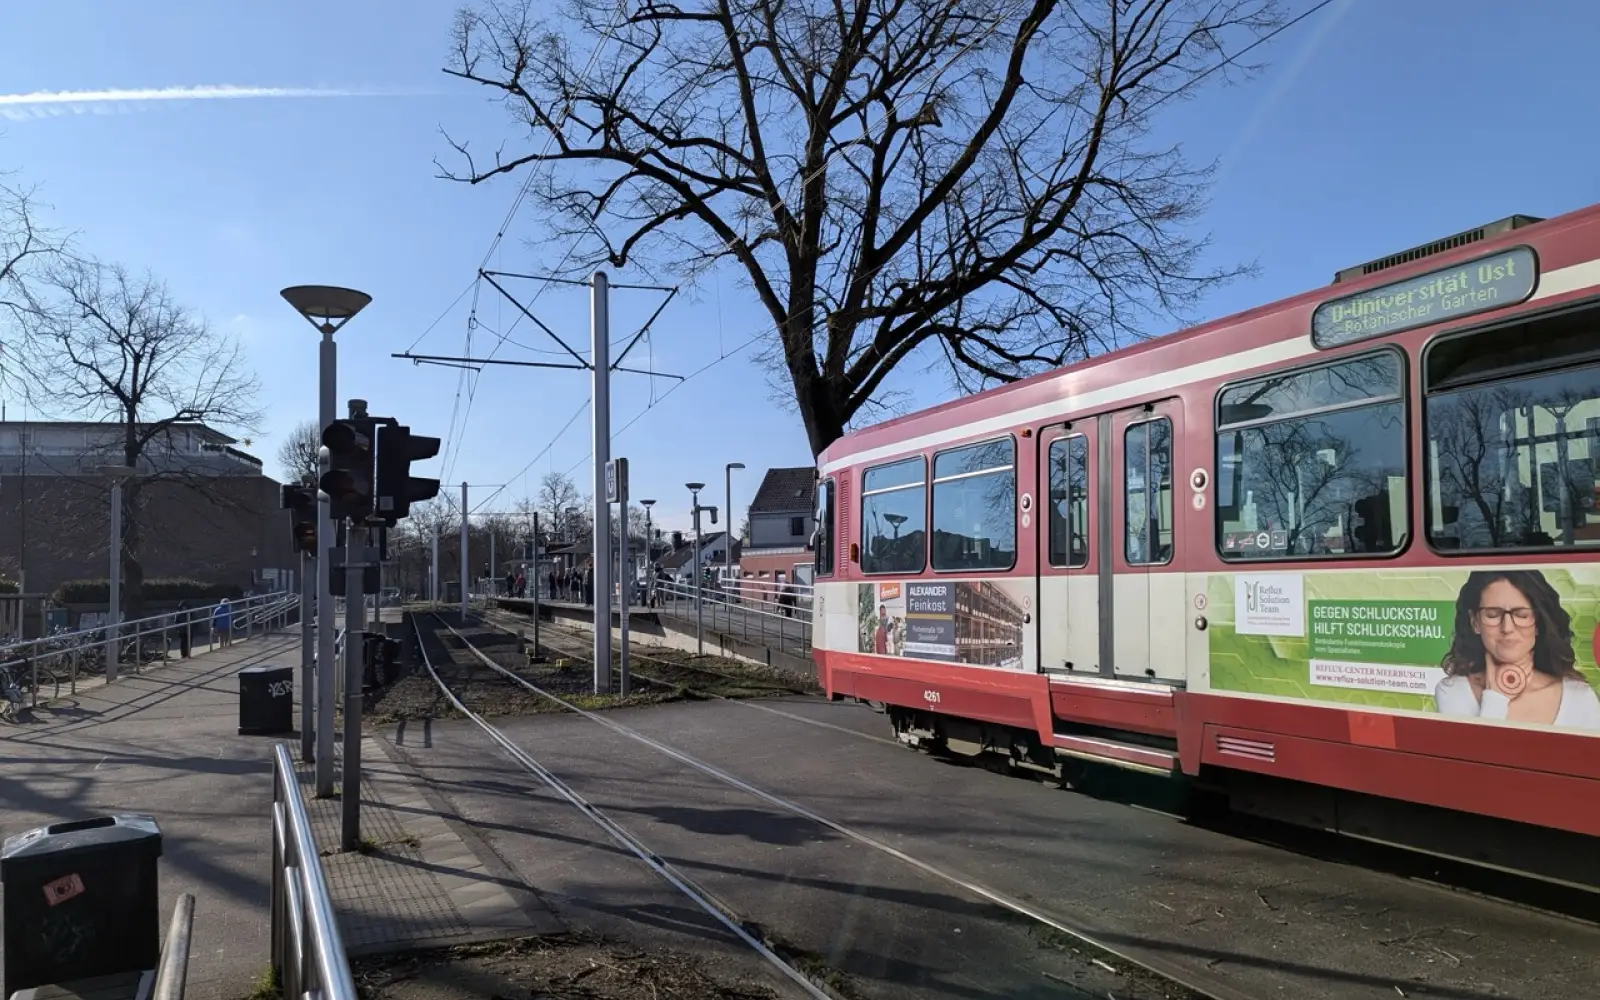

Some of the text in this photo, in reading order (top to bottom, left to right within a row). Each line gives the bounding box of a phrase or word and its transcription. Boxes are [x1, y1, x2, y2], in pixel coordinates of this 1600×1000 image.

[1442, 287, 1498, 310] Garten
[909, 586, 947, 597] ALEXANDER
[1260, 585, 1282, 594] Reflux
[909, 598, 947, 612] Feinkost
[1260, 594, 1290, 604] Solution
[1260, 603, 1280, 613] Team
[1313, 606, 1437, 621] GEGEN SCHLUCKSTAU
[1314, 622, 1445, 638] HILFT SCHLUCKSCHAU.
[1375, 669, 1426, 679] MEERBUSCH
[1316, 674, 1427, 690] www.reflux-solution-team.com
[924, 690, 940, 703] 4261
